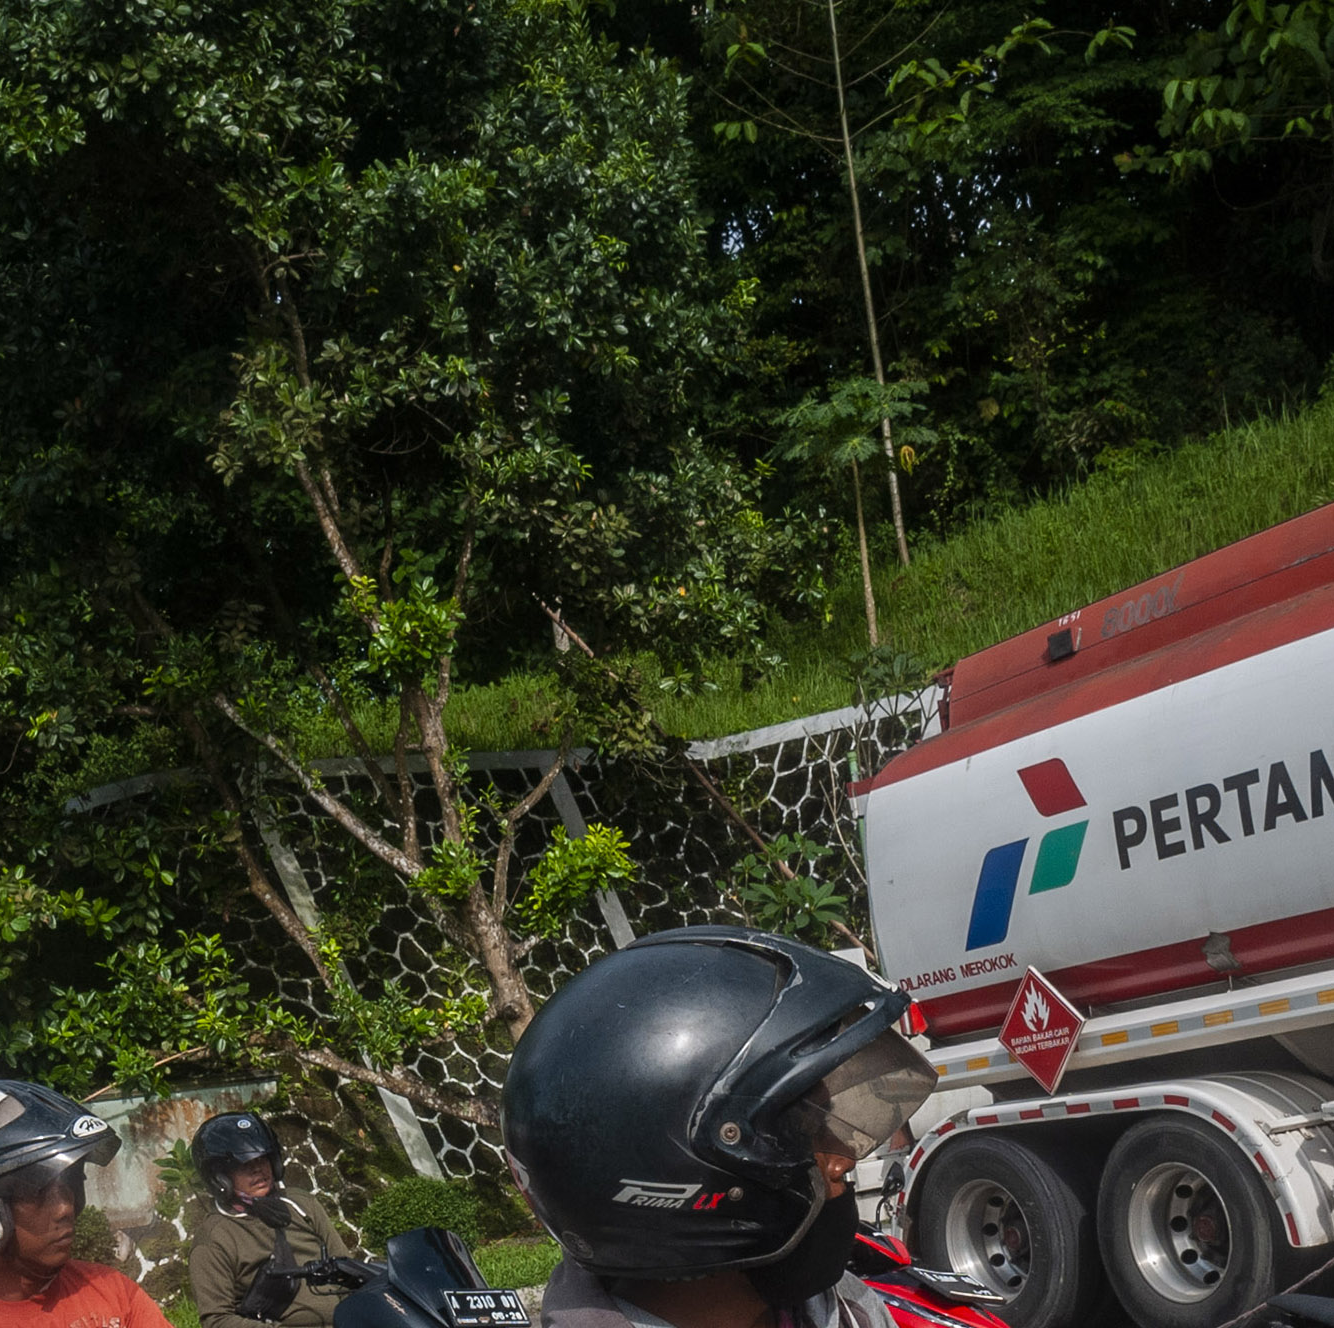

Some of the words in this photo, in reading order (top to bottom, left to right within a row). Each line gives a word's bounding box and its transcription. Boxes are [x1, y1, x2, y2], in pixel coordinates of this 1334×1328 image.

[899, 967, 957, 992] DILARANG
[960, 953, 1018, 978] MEROKOK
[1011, 1034, 1032, 1047] BAHAN
[1032, 1030, 1053, 1043] BAKAR
[1054, 1027, 1070, 1039] CAIR
[1014, 1044, 1037, 1056] MUDAH
[1037, 1037, 1070, 1051] TERBAKAR
[693, 1192, 726, 1209] LX
[451, 1295, 460, 1310] A
[466, 1295, 496, 1310] 2310
